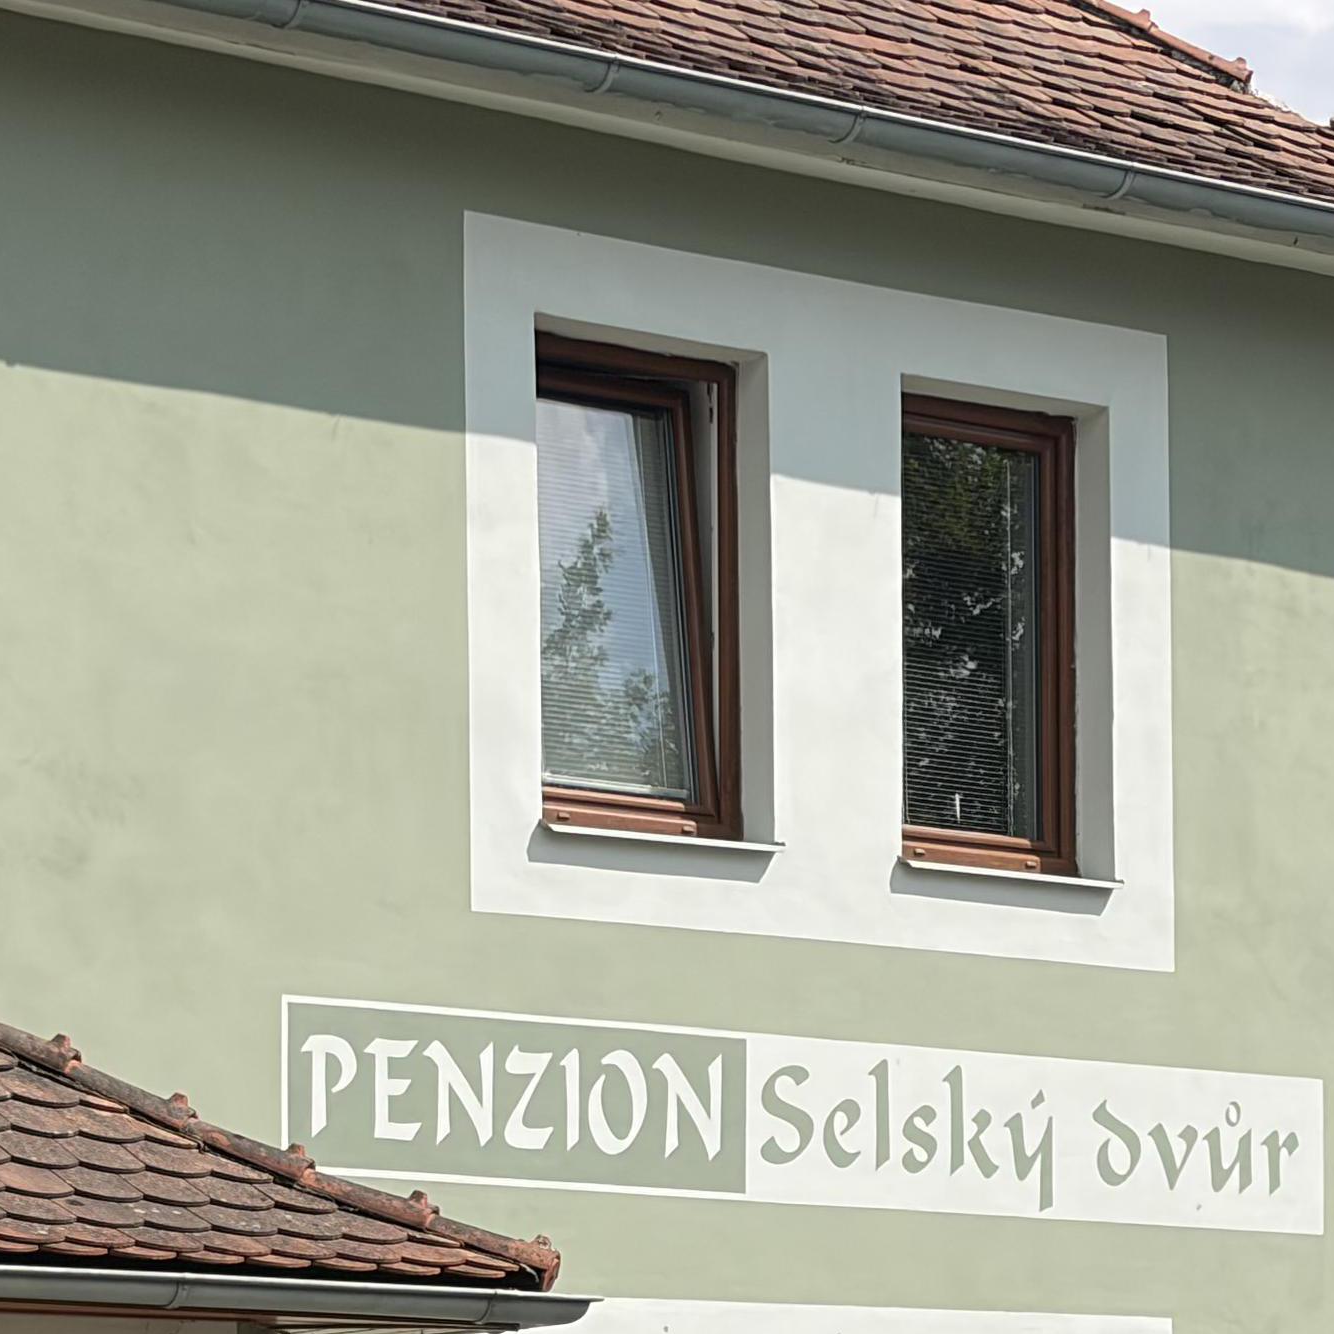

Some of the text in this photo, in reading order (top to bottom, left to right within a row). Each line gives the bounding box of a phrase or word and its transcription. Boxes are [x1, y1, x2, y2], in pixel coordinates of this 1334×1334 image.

[300, 1033, 1299, 1212] PENZION Selský dvůr
